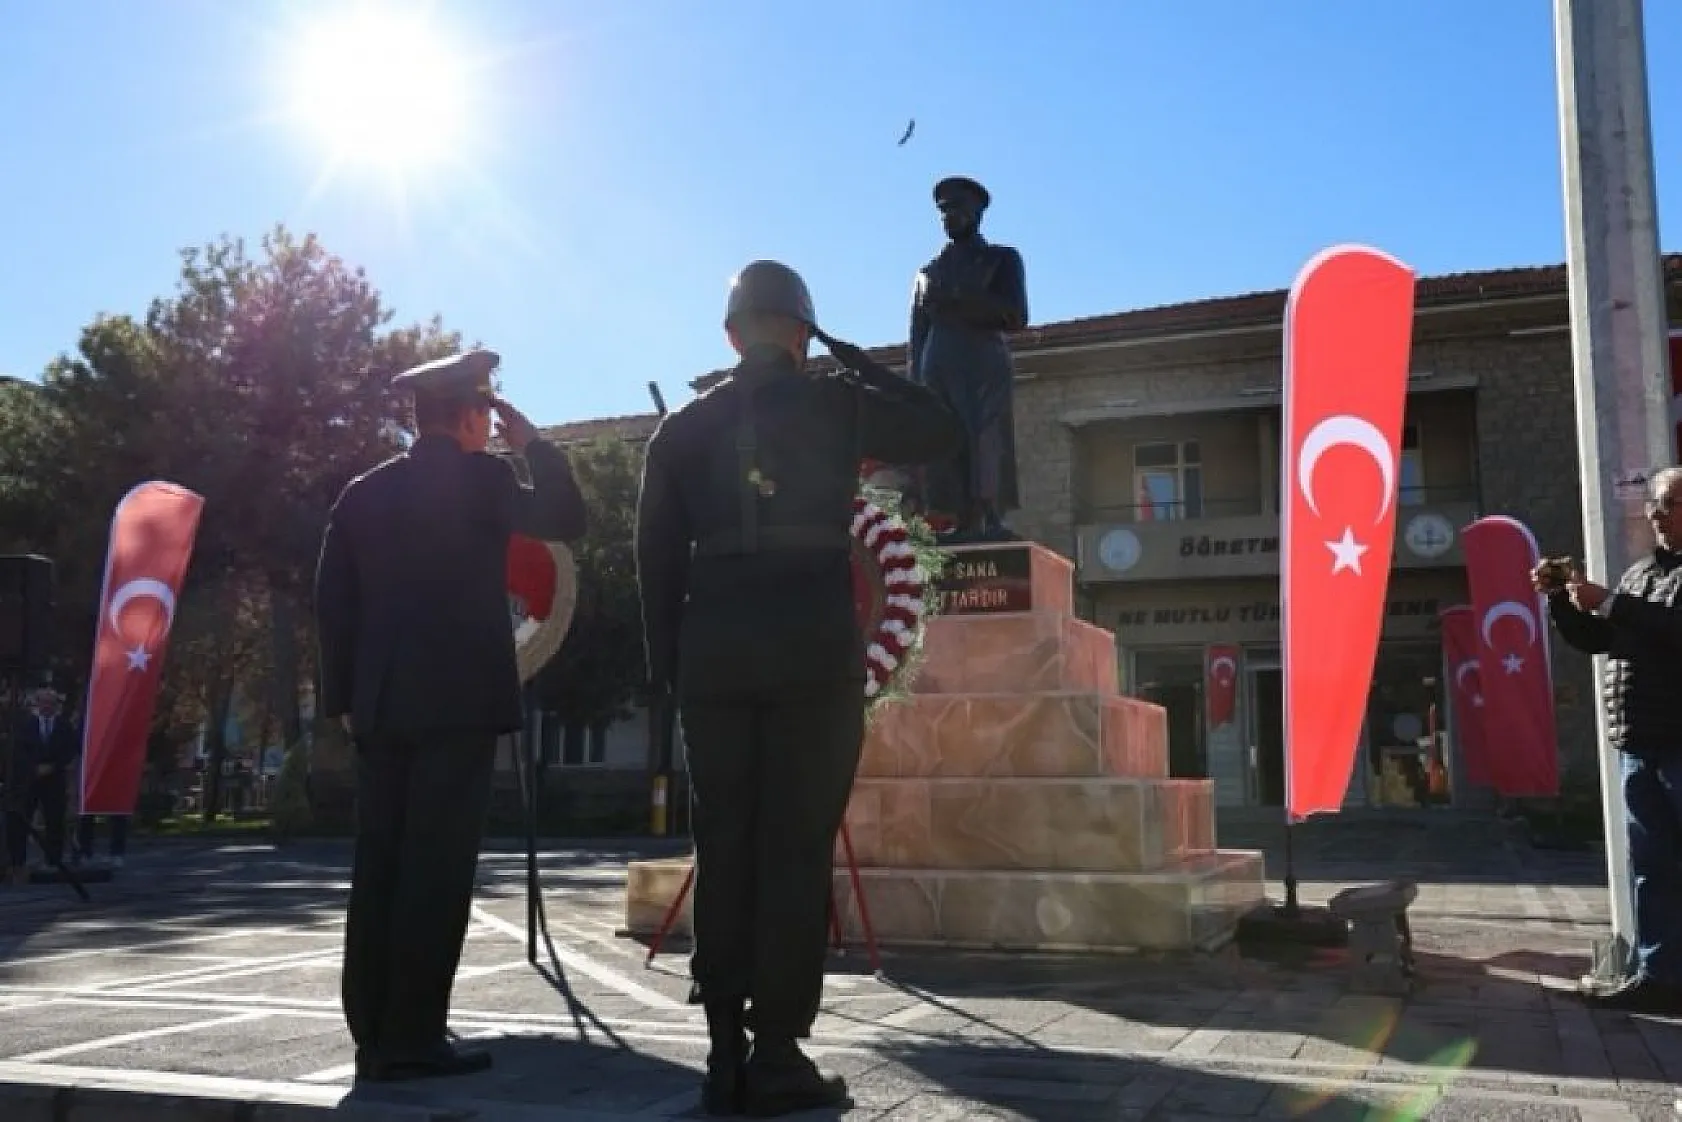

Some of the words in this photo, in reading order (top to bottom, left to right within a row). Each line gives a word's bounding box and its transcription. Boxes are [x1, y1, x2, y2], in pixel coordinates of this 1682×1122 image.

[1180, 535, 1279, 556] ÖĞRETM
[956, 560, 998, 579] SANA
[1118, 610, 1147, 625] NE
[1153, 607, 1230, 624] MUTLU
[1238, 603, 1279, 622] TÜR
